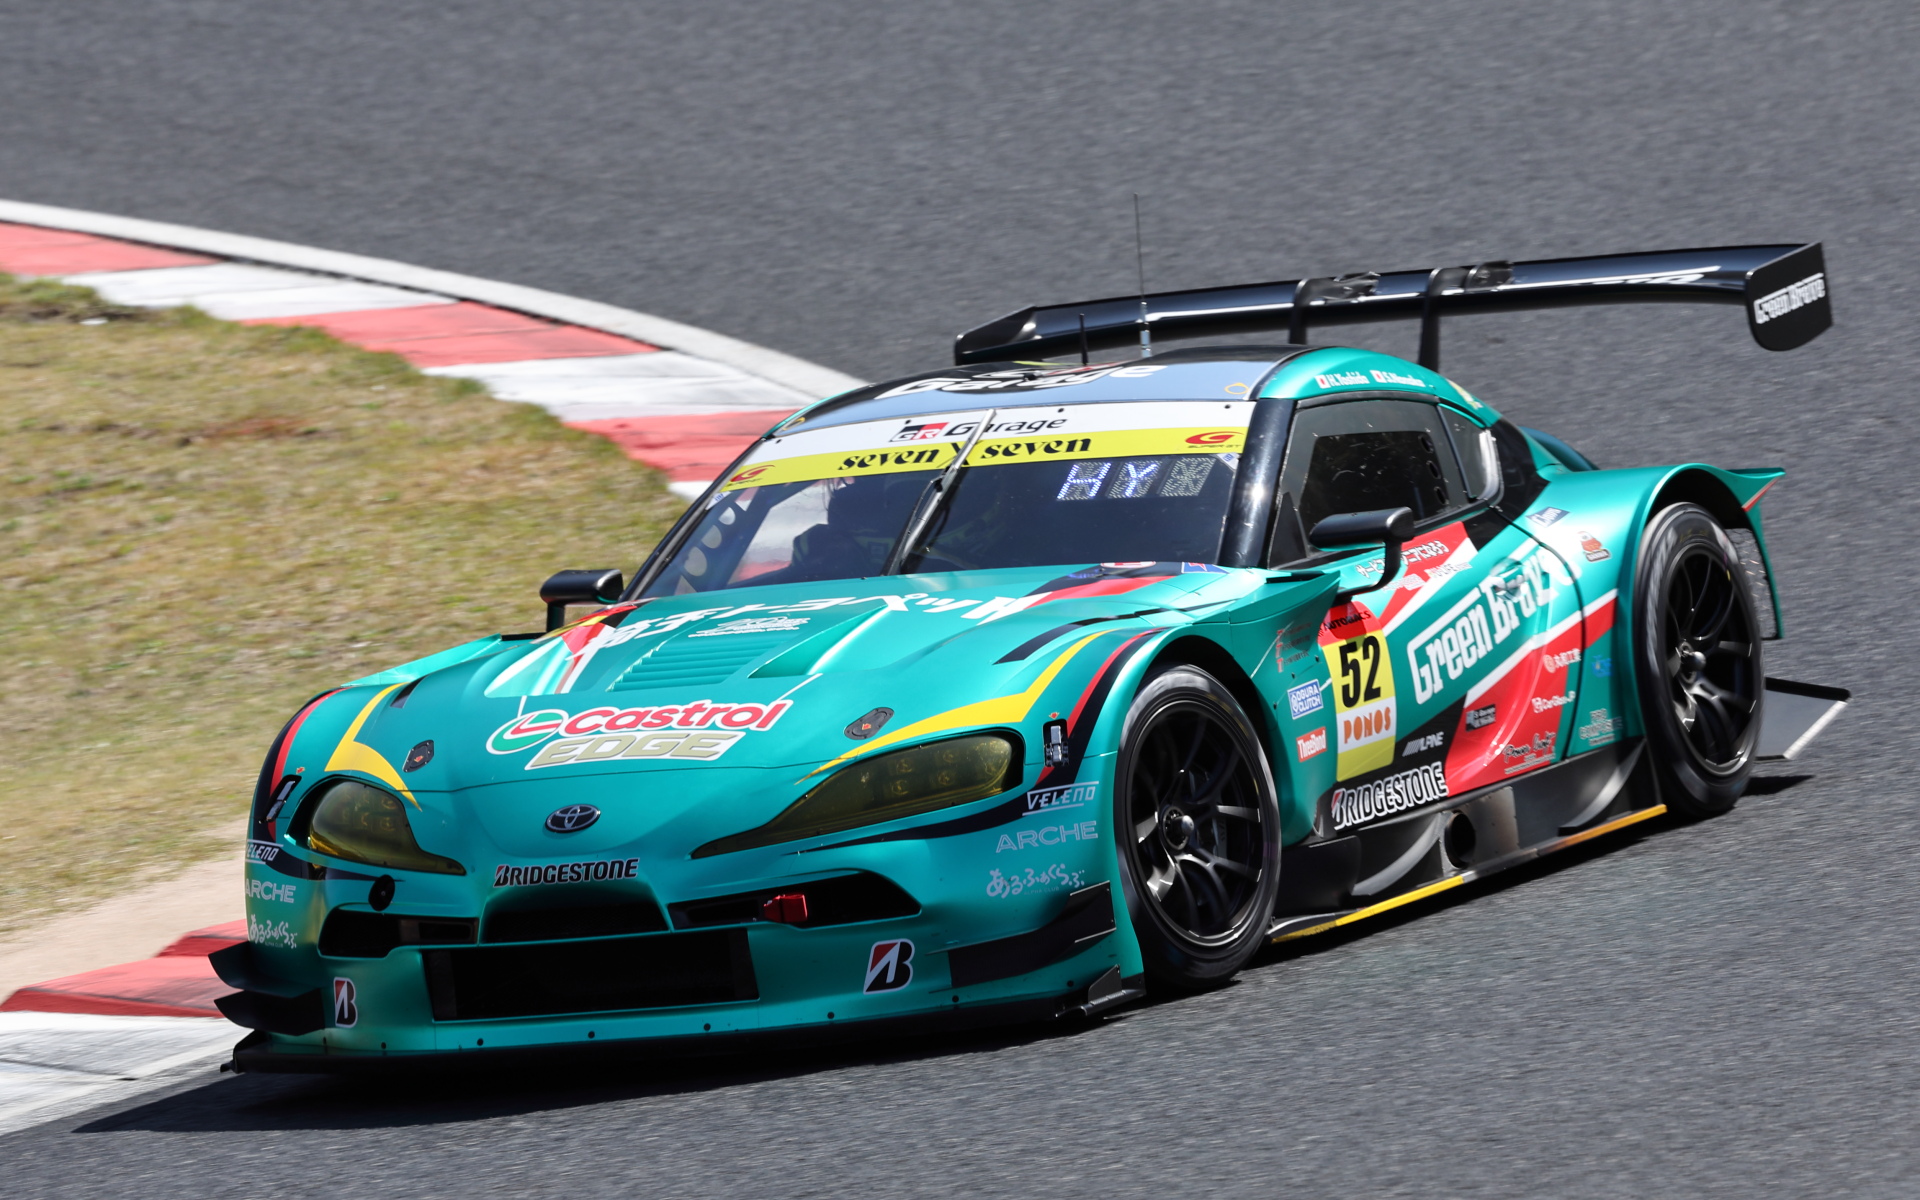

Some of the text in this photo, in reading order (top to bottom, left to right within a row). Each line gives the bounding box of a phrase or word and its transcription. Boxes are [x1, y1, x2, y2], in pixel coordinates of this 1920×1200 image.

[838, 449, 940, 470] seven
[980, 437, 1092, 459] seven
[1407, 587, 1493, 705] Green
[1339, 635, 1382, 708] 52
[563, 701, 788, 735] Castrol
[1343, 706, 1391, 744] PONOS
[529, 733, 739, 768] EDGE
[1027, 786, 1096, 810] VELENO
[1331, 761, 1449, 830] BRIDGESTONE
[996, 820, 1099, 853] ARCHE
[494, 858, 640, 888] BRIDGESTONE
